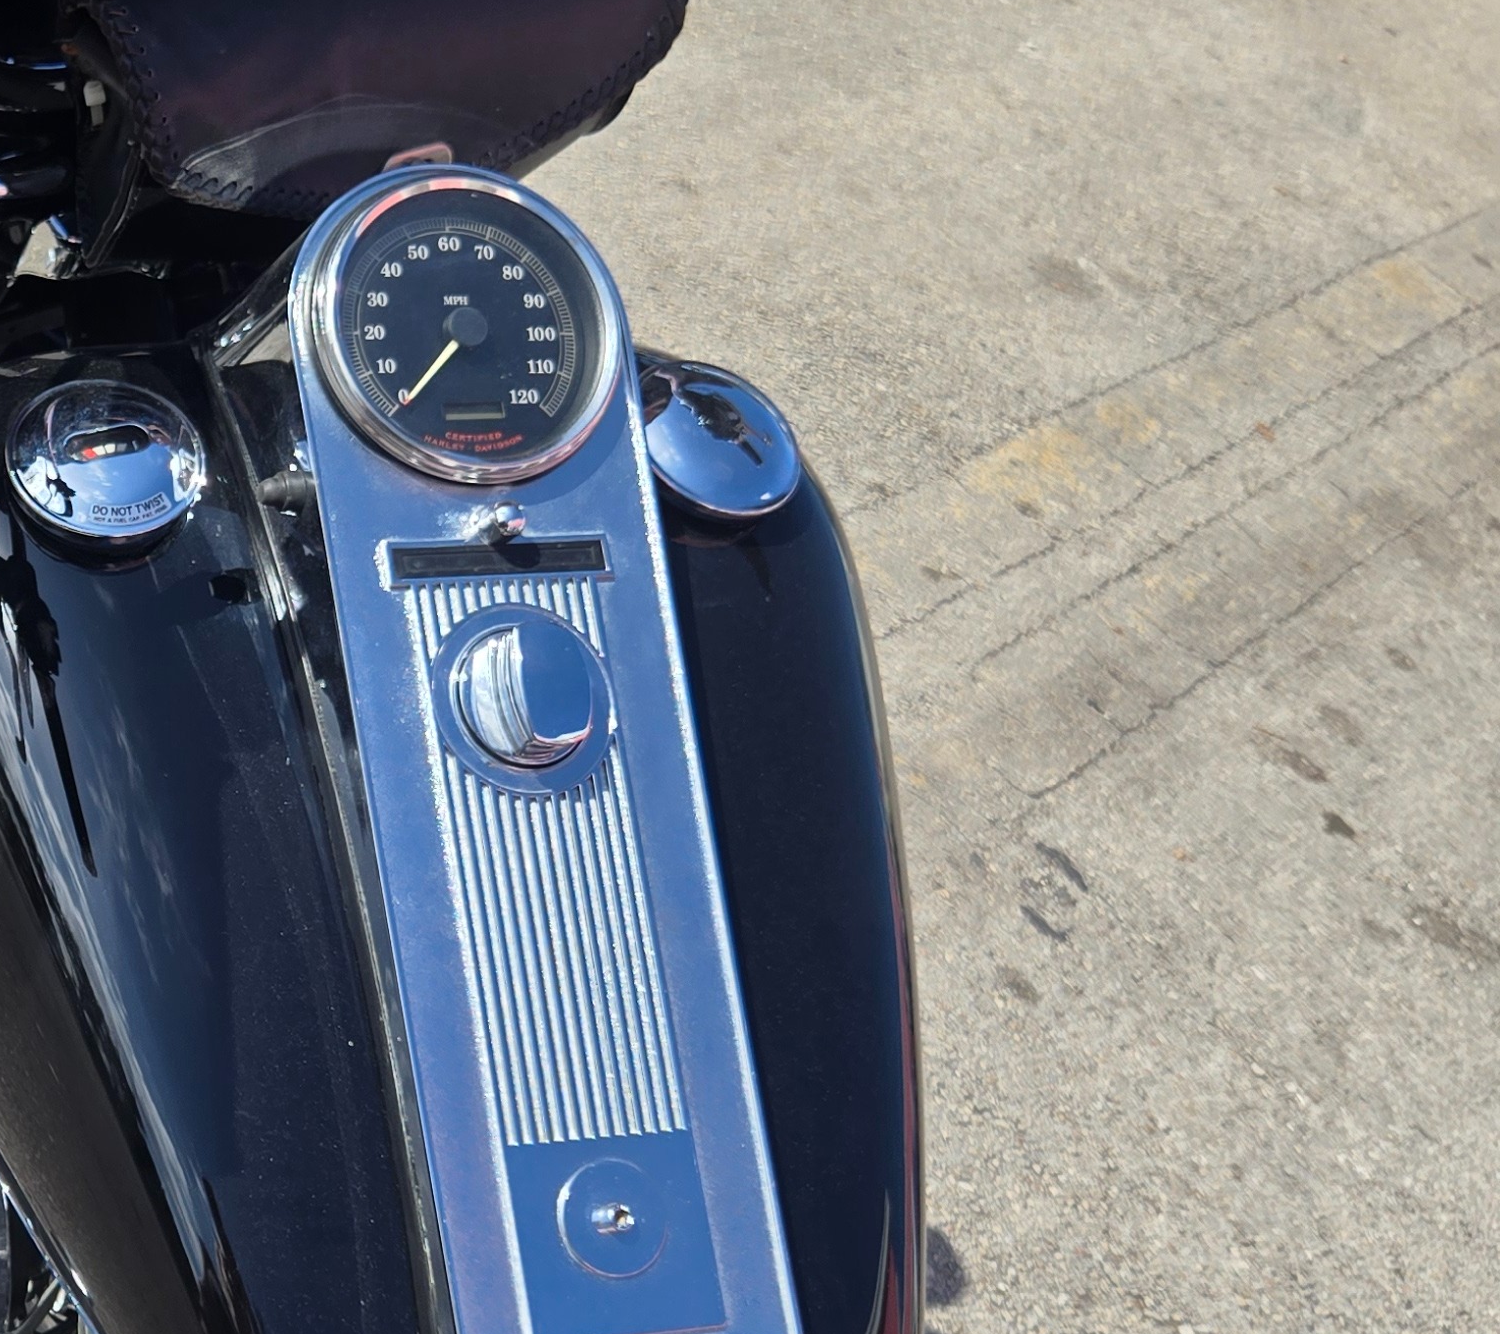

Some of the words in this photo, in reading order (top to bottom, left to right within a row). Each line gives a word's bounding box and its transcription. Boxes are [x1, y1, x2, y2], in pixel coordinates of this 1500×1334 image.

[437, 237, 460, 252] 60
[407, 245, 429, 260] 50
[474, 245, 494, 260] 70
[380, 263, 402, 278] 40
[502, 265, 523, 280] 80
[367, 292, 388, 307] 30
[443, 295, 468, 306] MPH
[523, 294, 545, 309] 90
[364, 325, 385, 341] 20
[526, 327, 556, 342] 100
[376, 358, 397, 374] 10
[527, 359, 554, 374] 110
[398, 389, 409, 405] 0
[509, 389, 538, 405] 120
[445, 430, 503, 443] CERTIFIED
[92, 505, 109, 516] DO
[111, 505, 133, 517] NOT
[135, 493, 165, 514] TWIST
